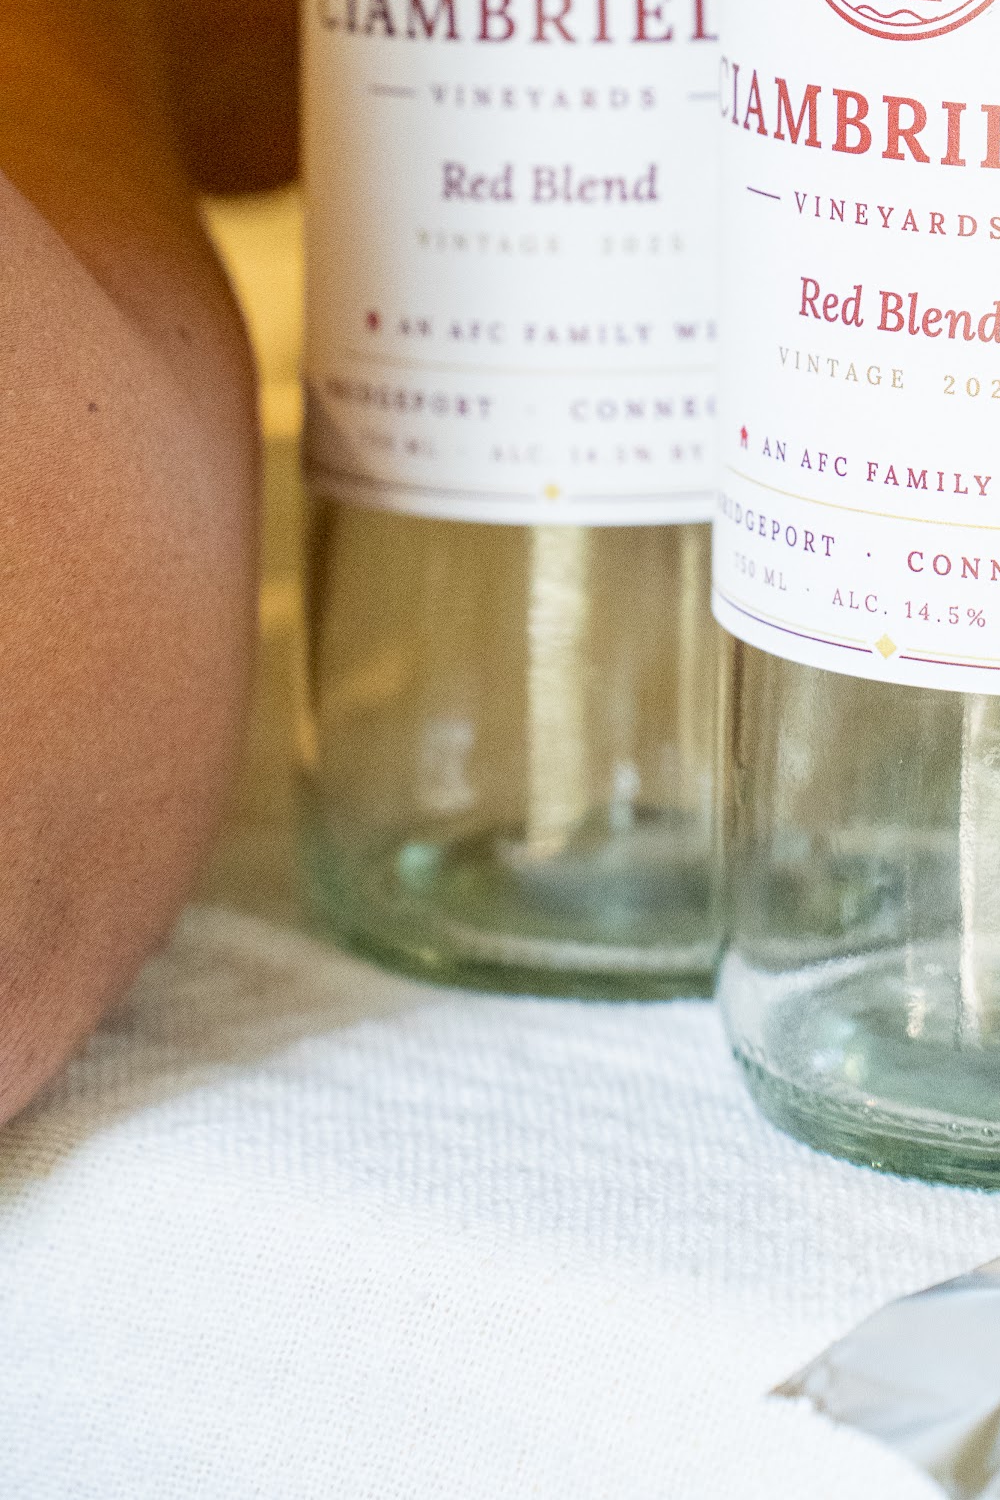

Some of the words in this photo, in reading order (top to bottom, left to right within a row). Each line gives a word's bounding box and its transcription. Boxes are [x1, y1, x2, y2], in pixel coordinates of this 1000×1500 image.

[440, 160, 515, 204] Red
[529, 160, 660, 204] Blend
[798, 276, 865, 328] Red
[777, 346, 906, 391] VINTAGE
[761, 436, 788, 465] AN
[799, 447, 850, 478] AFC
[865, 461, 993, 498] FAMILY
[718, 491, 836, 558] RIDGEPORT
[763, 565, 788, 592] ML
[831, 588, 890, 616] ALC.
[904, 600, 987, 629] 14.5%
